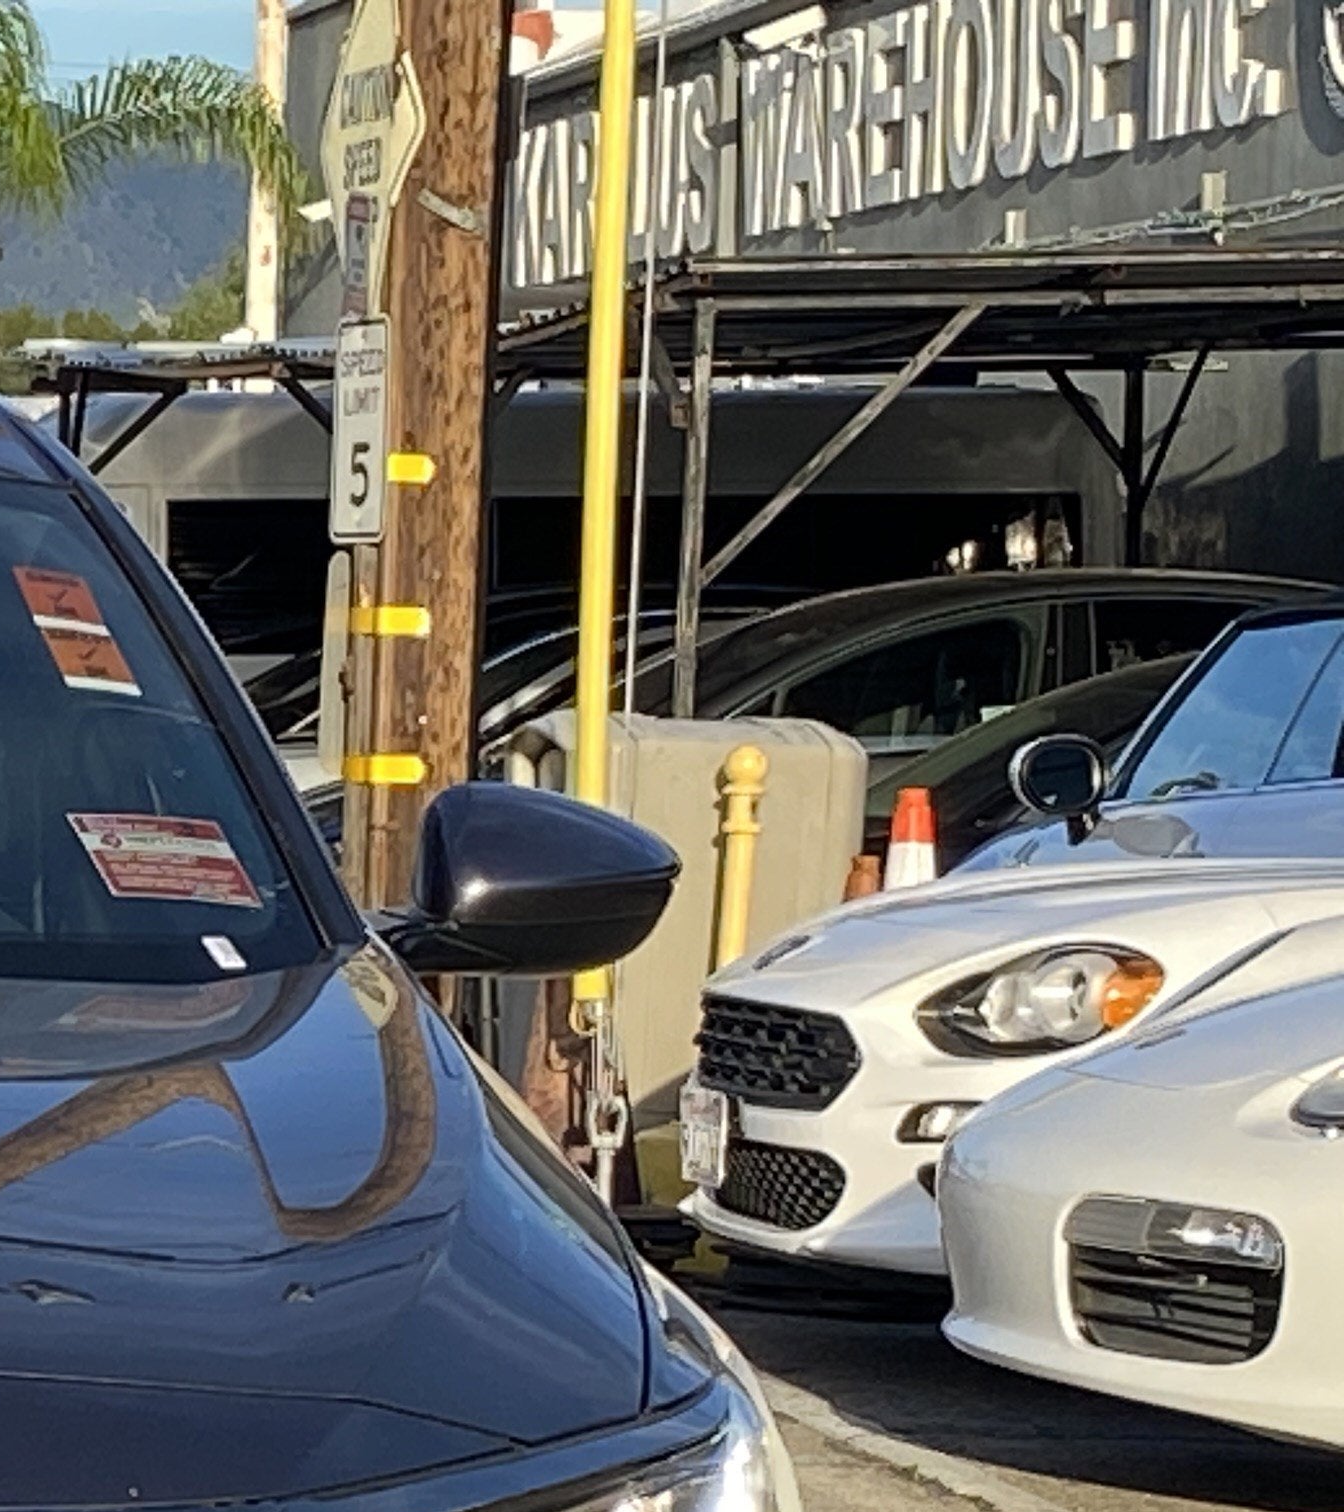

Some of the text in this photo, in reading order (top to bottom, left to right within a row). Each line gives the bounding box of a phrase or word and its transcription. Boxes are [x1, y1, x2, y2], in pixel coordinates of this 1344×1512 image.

[343, 137, 381, 190] SPEED
[510, 72, 719, 288] KARLUS
[741, 0, 1136, 236] WAREHOUSE
[341, 348, 384, 378] SPEED
[343, 386, 381, 417] LIMIT
[348, 441, 371, 507] 5
